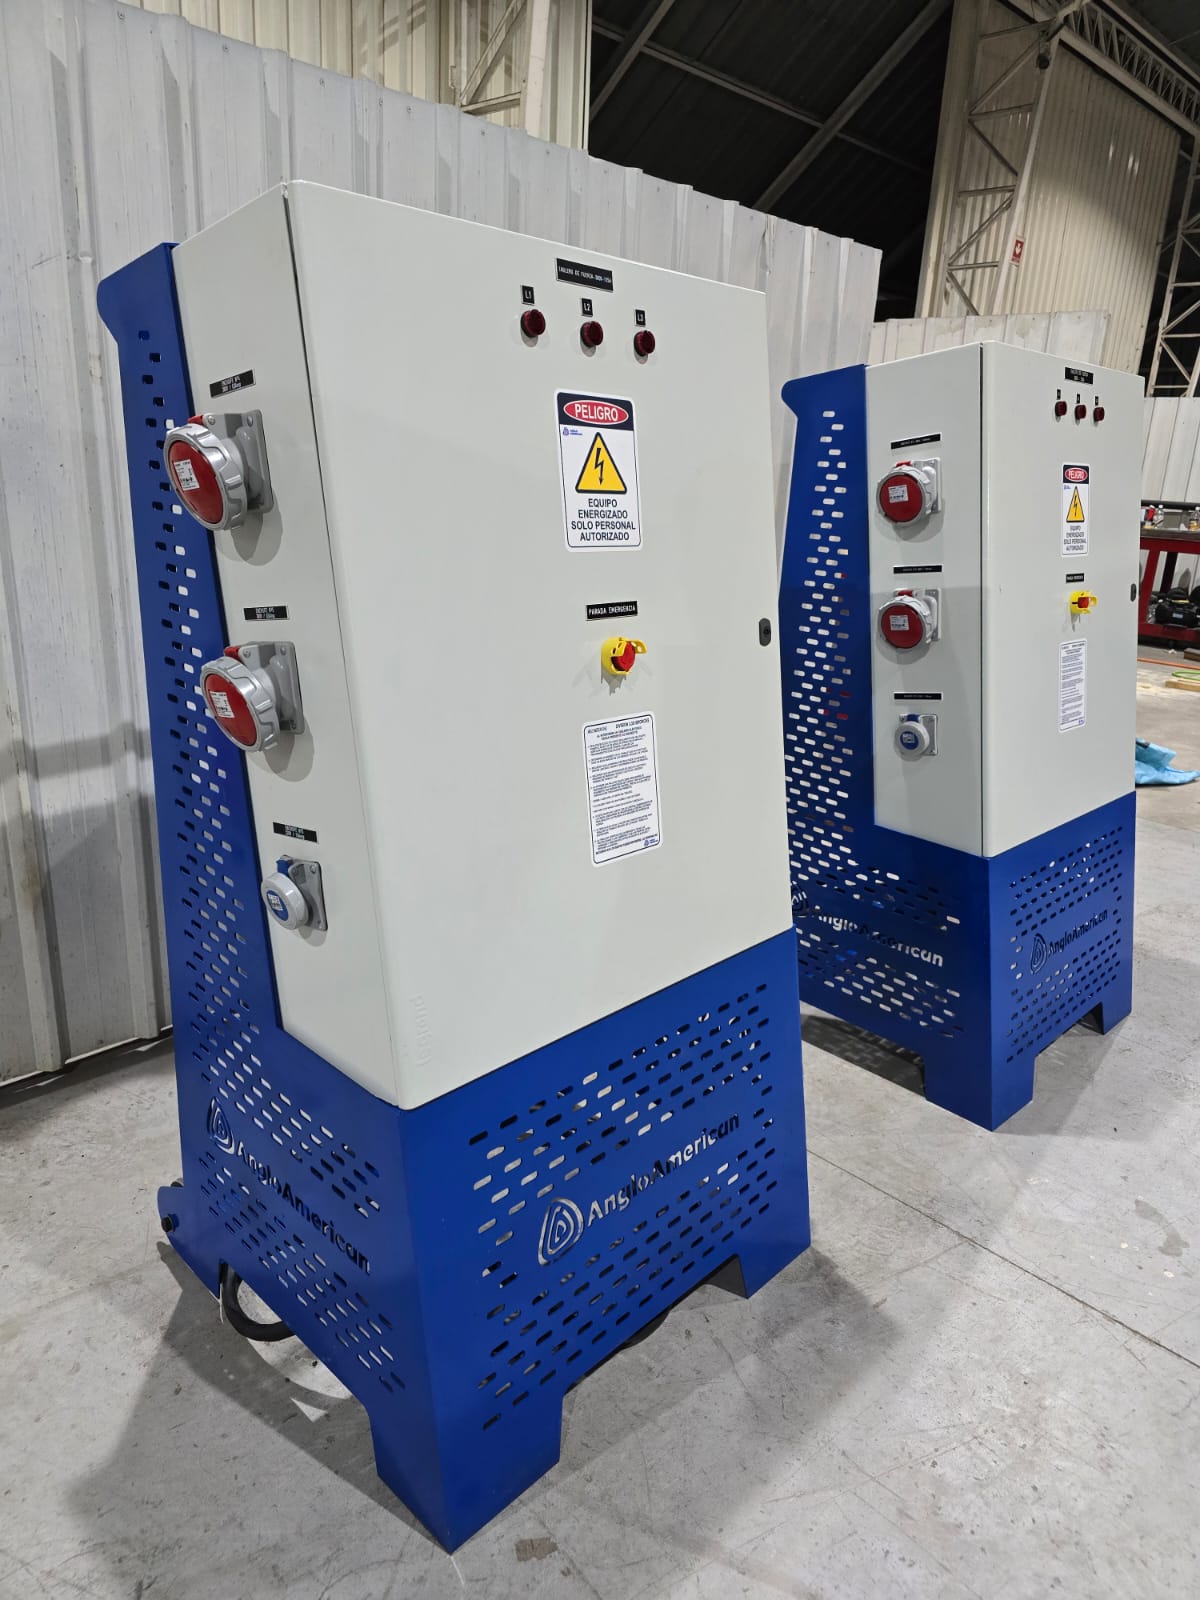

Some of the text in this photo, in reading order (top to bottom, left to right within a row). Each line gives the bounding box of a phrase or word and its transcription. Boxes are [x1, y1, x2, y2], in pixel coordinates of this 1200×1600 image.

[524, 289, 532, 299] L1
[583, 303, 591, 312] L2
[574, 403, 619, 422] PELIGRO
[588, 498, 618, 508] EQUIPO
[578, 509, 628, 519] ENERGIZADO
[571, 520, 636, 530] SOLO PERSONAL
[579, 531, 630, 542] AUTORIZADO
[1048, 909, 1108, 958] AngloAmerican
[587, 1113, 740, 1227] AngloAmerican
[237, 1140, 371, 1276] AngloAmerican
